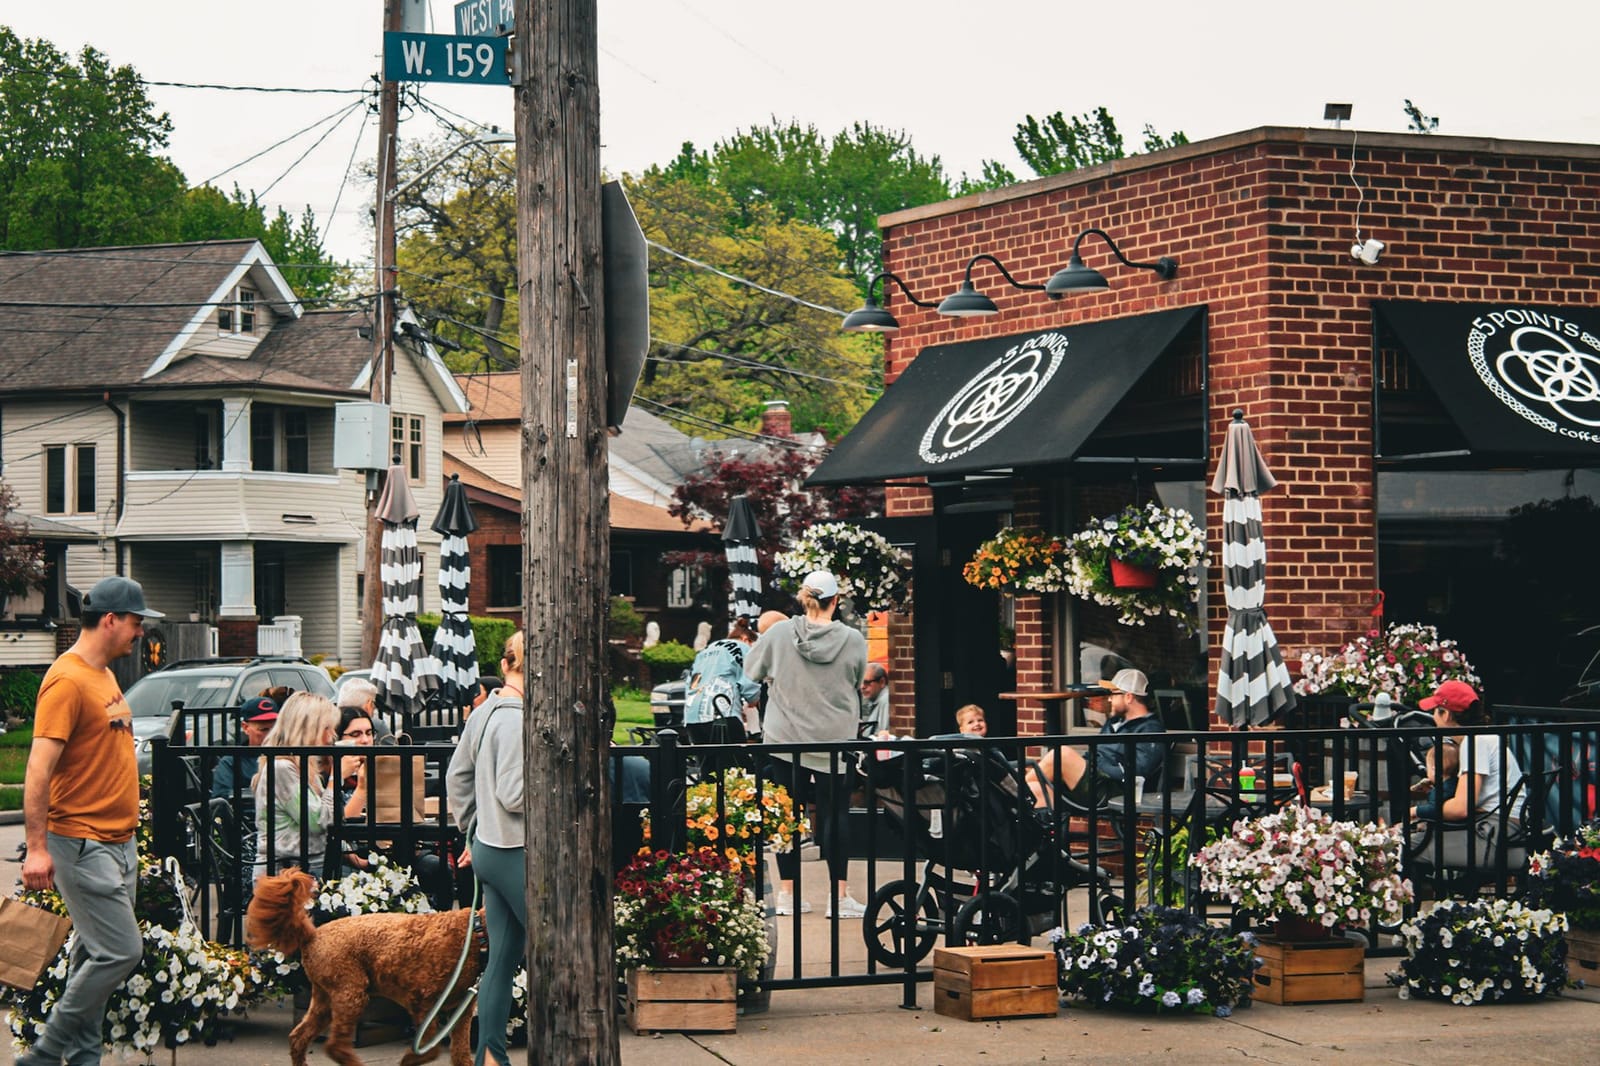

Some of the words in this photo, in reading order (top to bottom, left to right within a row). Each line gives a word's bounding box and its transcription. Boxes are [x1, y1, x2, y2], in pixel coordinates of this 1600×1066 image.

[461, 0, 492, 36] WEST
[402, 40, 432, 76] W.
[446, 43, 494, 78] 159
[1472, 317, 1495, 336] 5
[1487, 309, 1580, 337] POINTS
[1002, 345, 1020, 364] 5
[1019, 332, 1069, 355] POINTS
[257, 699, 274, 711] C
